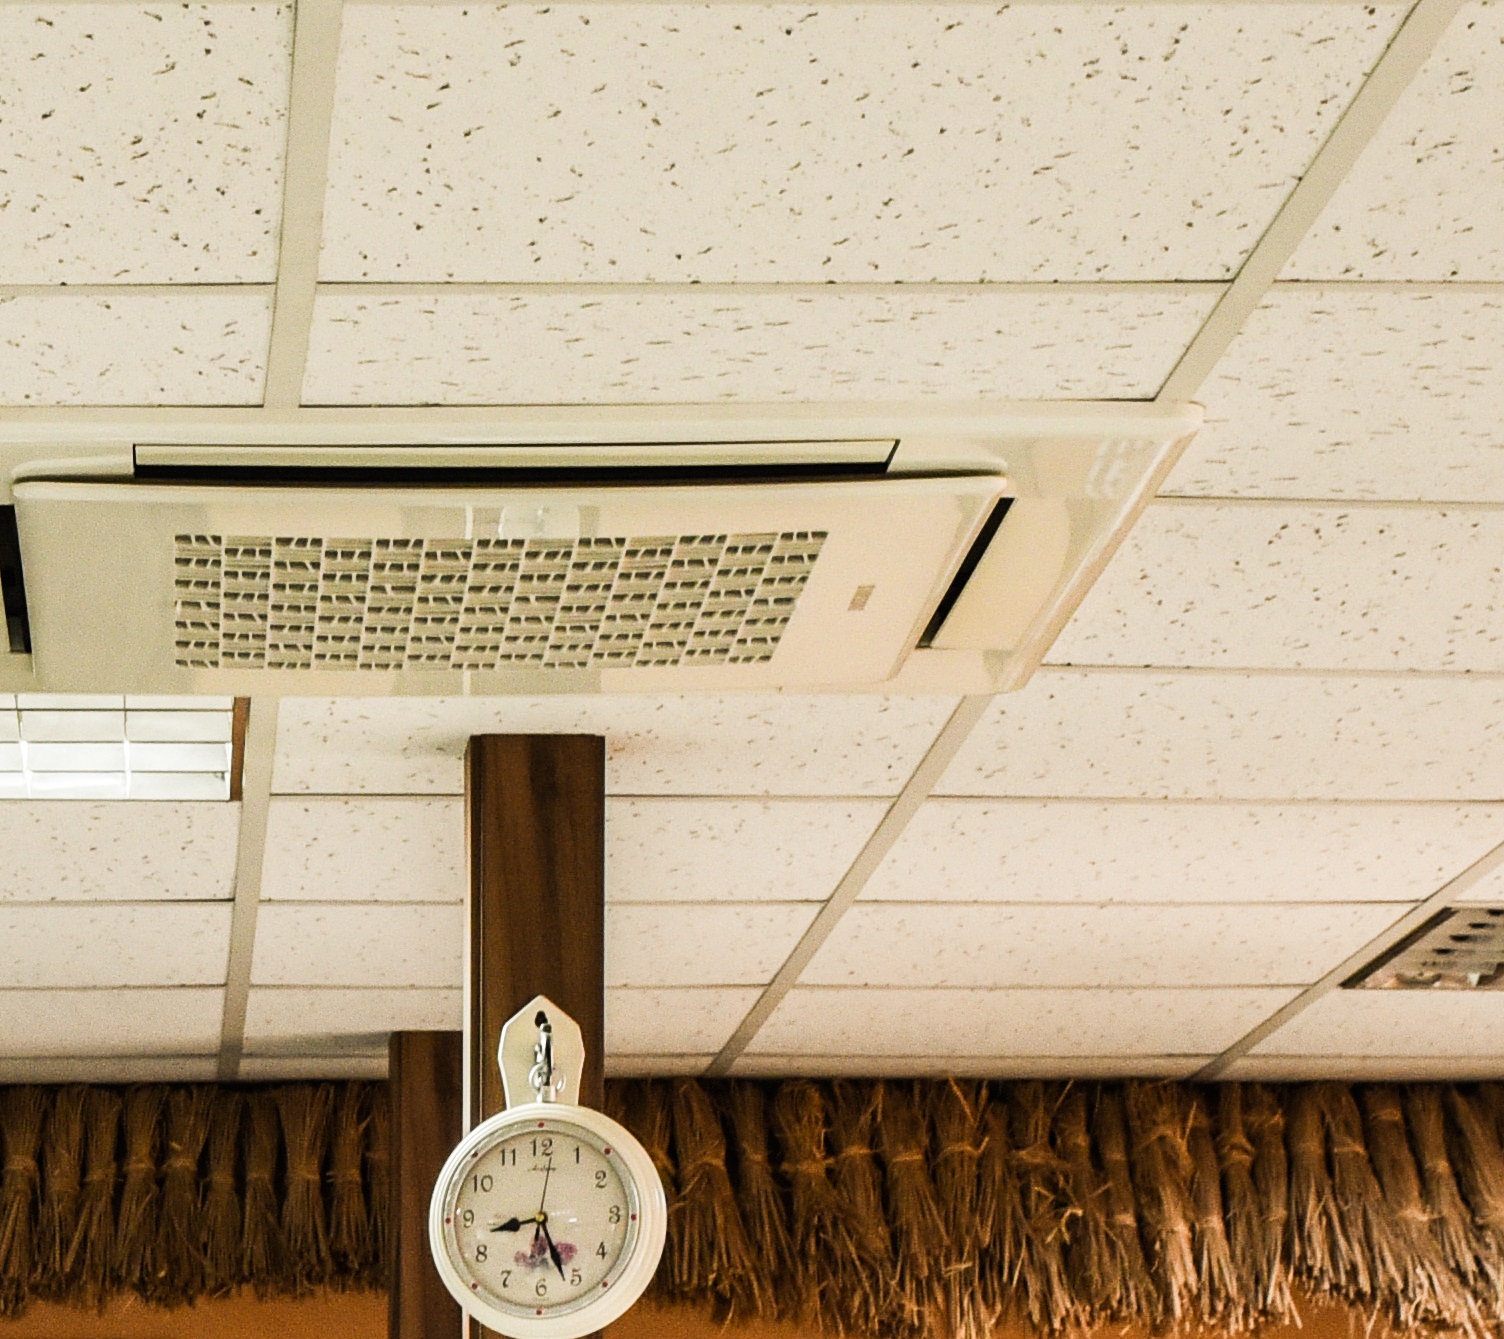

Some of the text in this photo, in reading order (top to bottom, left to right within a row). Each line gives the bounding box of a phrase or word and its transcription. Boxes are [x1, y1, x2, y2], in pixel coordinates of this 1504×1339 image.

[530, 1137, 553, 1157] 12
[574, 1146, 580, 1164] 1
[501, 1148, 516, 1166] 11
[473, 1174, 493, 1193] 10
[595, 1170, 607, 1189] 2
[463, 1209, 475, 1228] 9
[609, 1205, 621, 1224] 3
[475, 1244, 488, 1263] 8
[596, 1241, 607, 1260] 4
[501, 1270, 512, 1288] 7
[571, 1268, 582, 1286] 5
[535, 1278, 547, 1296] 6
